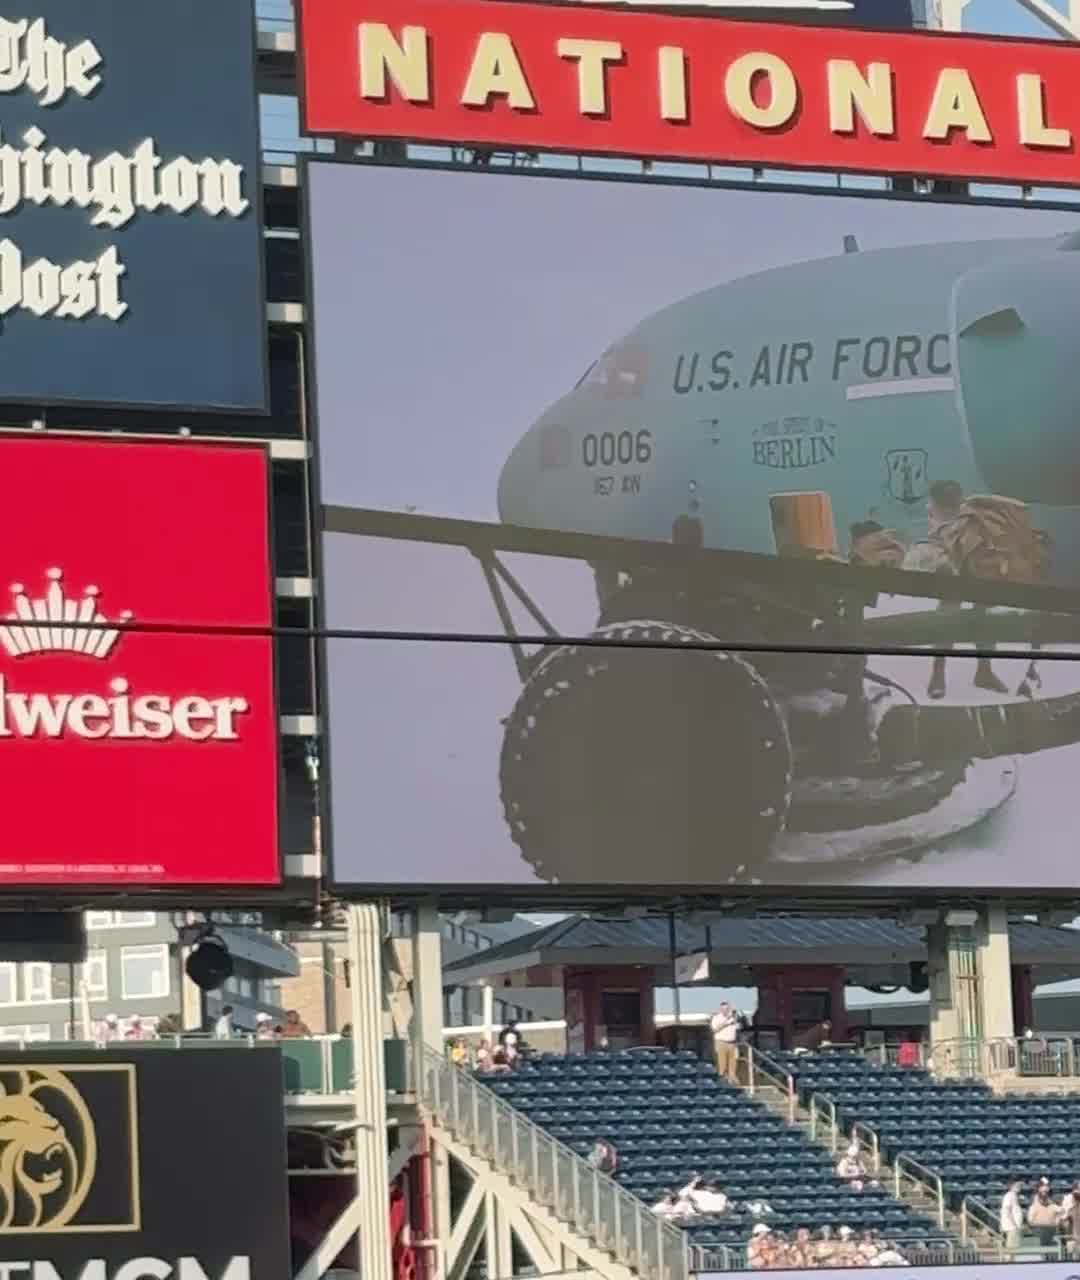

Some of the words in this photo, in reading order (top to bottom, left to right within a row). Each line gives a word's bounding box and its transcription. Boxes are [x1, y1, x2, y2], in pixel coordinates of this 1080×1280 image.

[672, 349, 740, 395] U.S.
[749, 340, 815, 387] AIR
[582, 429, 652, 467] 0006
[752, 435, 837, 470] BERLIN
[0, 673, 248, 740] weiser
